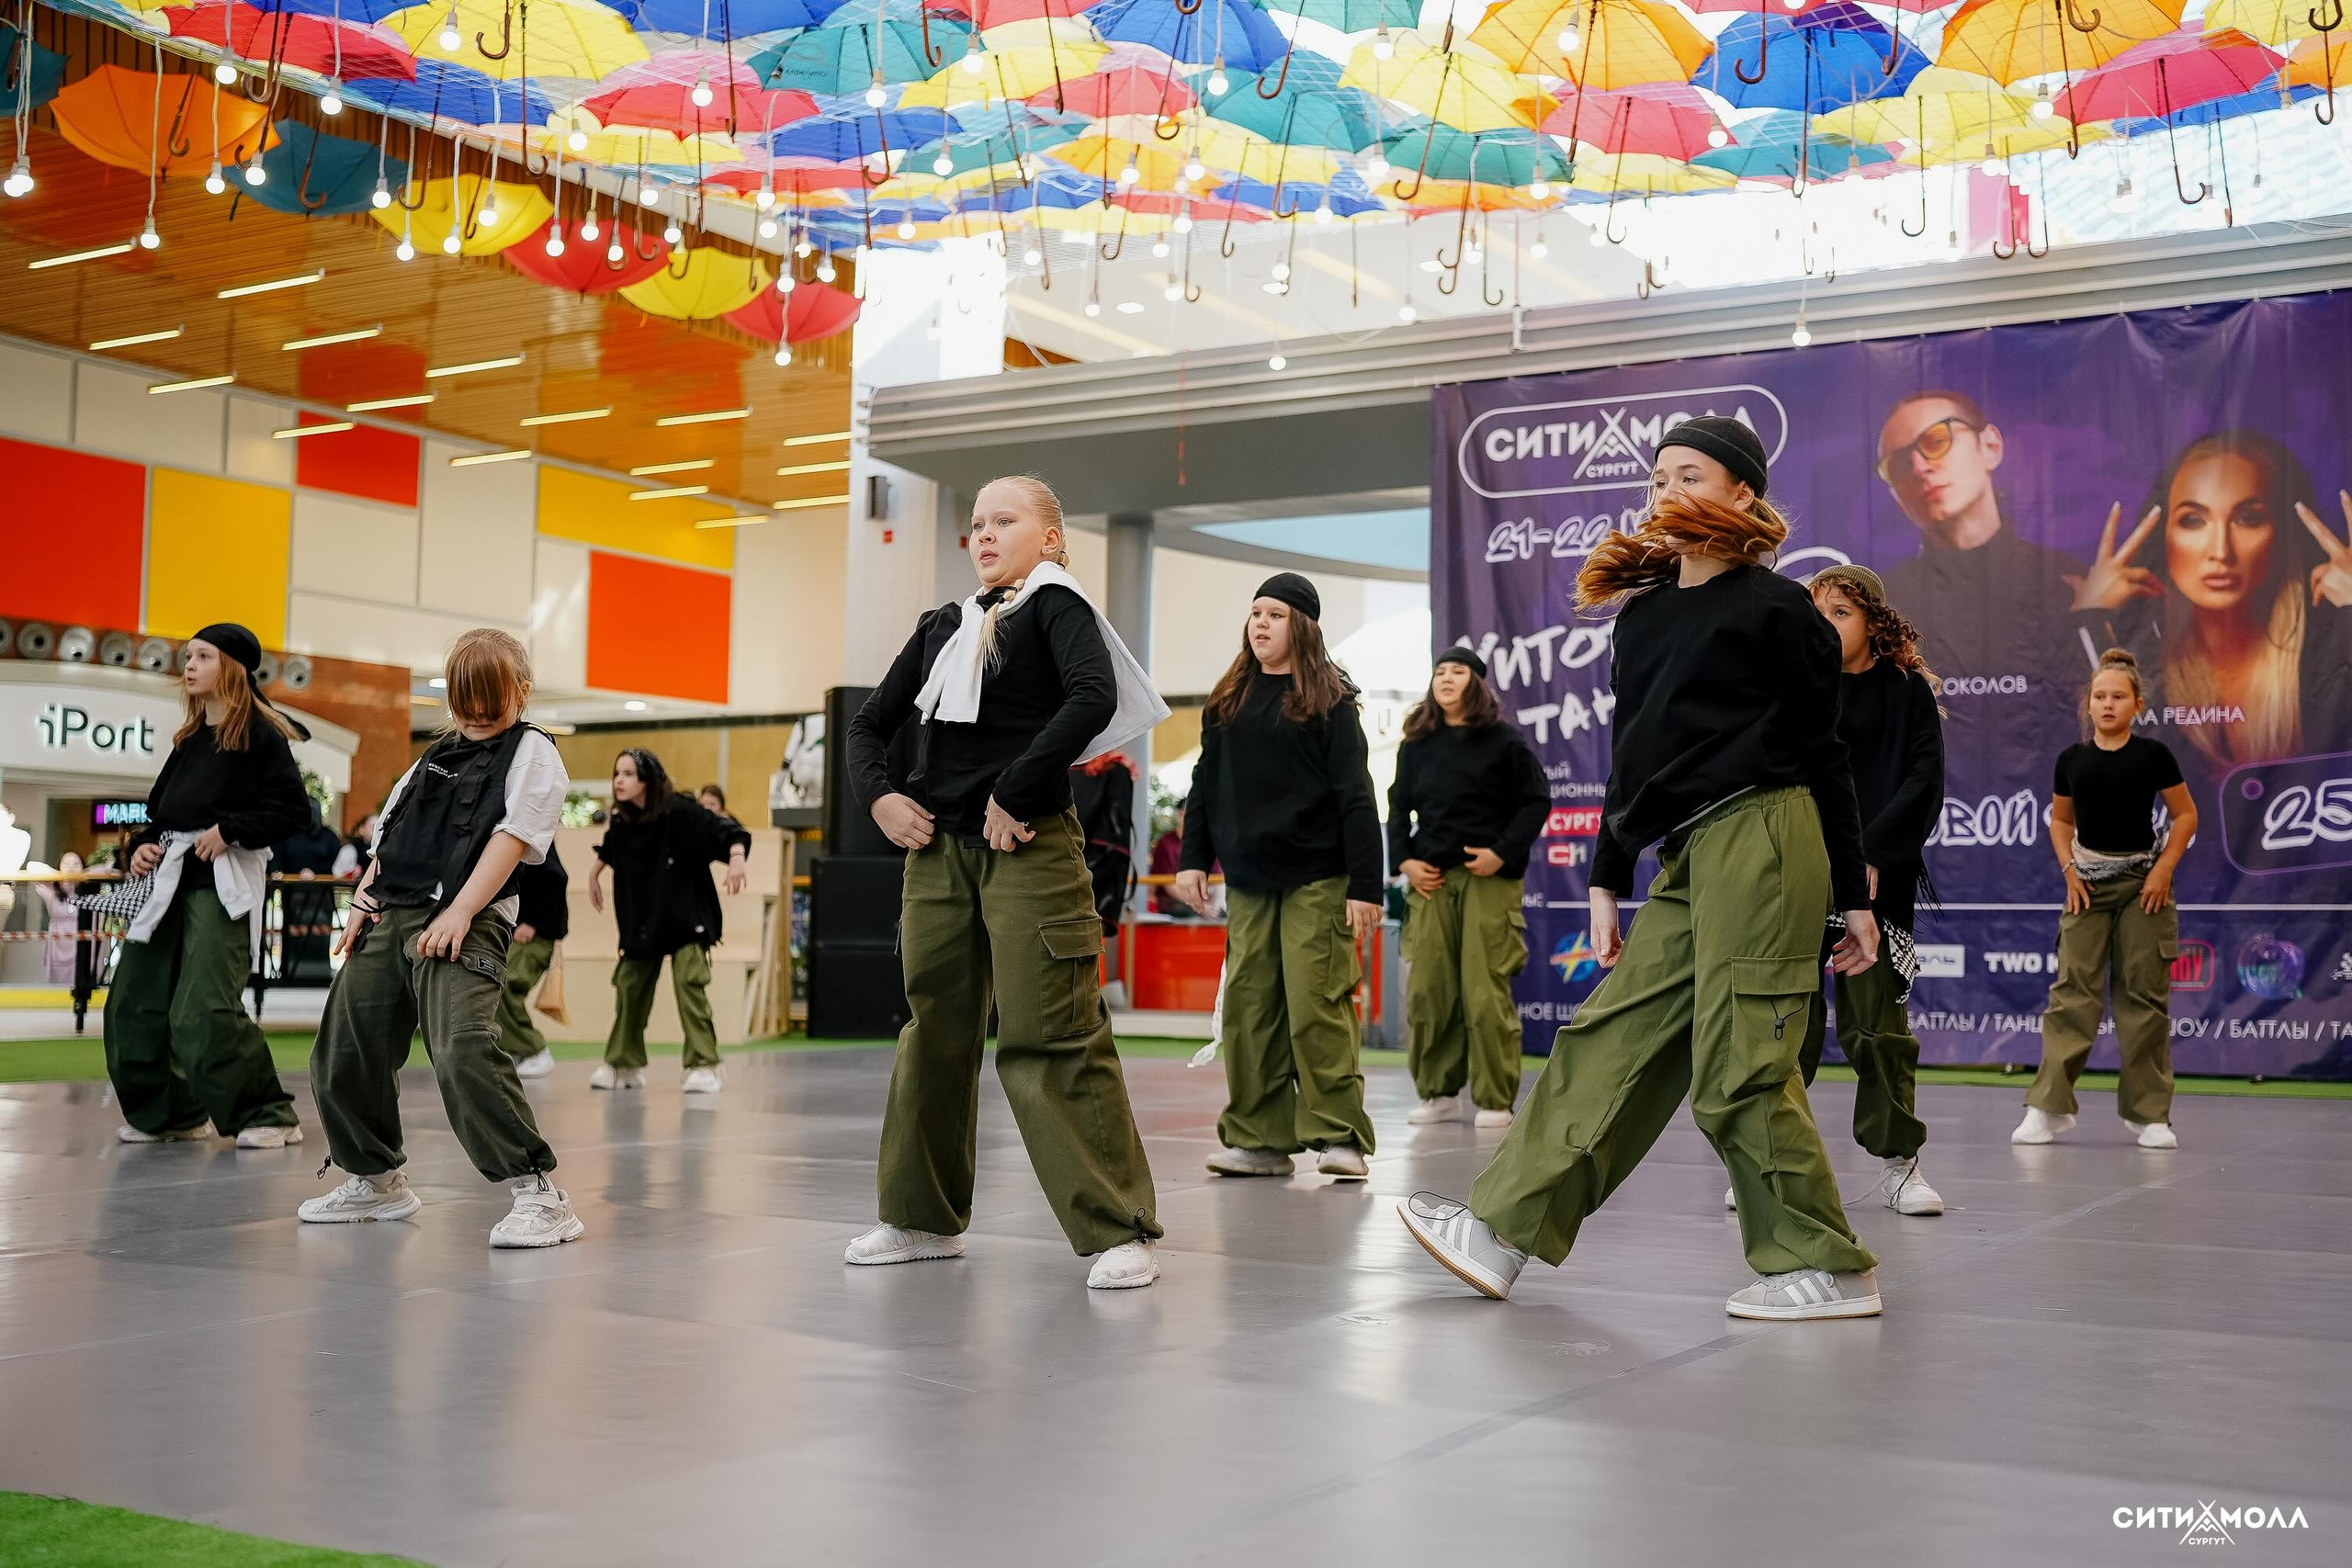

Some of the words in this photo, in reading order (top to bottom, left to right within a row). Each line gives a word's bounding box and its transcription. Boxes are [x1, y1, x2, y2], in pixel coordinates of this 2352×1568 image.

[1484, 420, 1597, 462] СИТИ
[1585, 460, 1639, 479] СУРГУТ
[1485, 514, 1612, 563] 21-22
[2163, 705, 2246, 728] РЕДИНА
[39, 705, 154, 753] iPort
[1983, 952, 2043, 974] TWO
[2229, 1018, 2310, 1040] БАТТЛЫ
